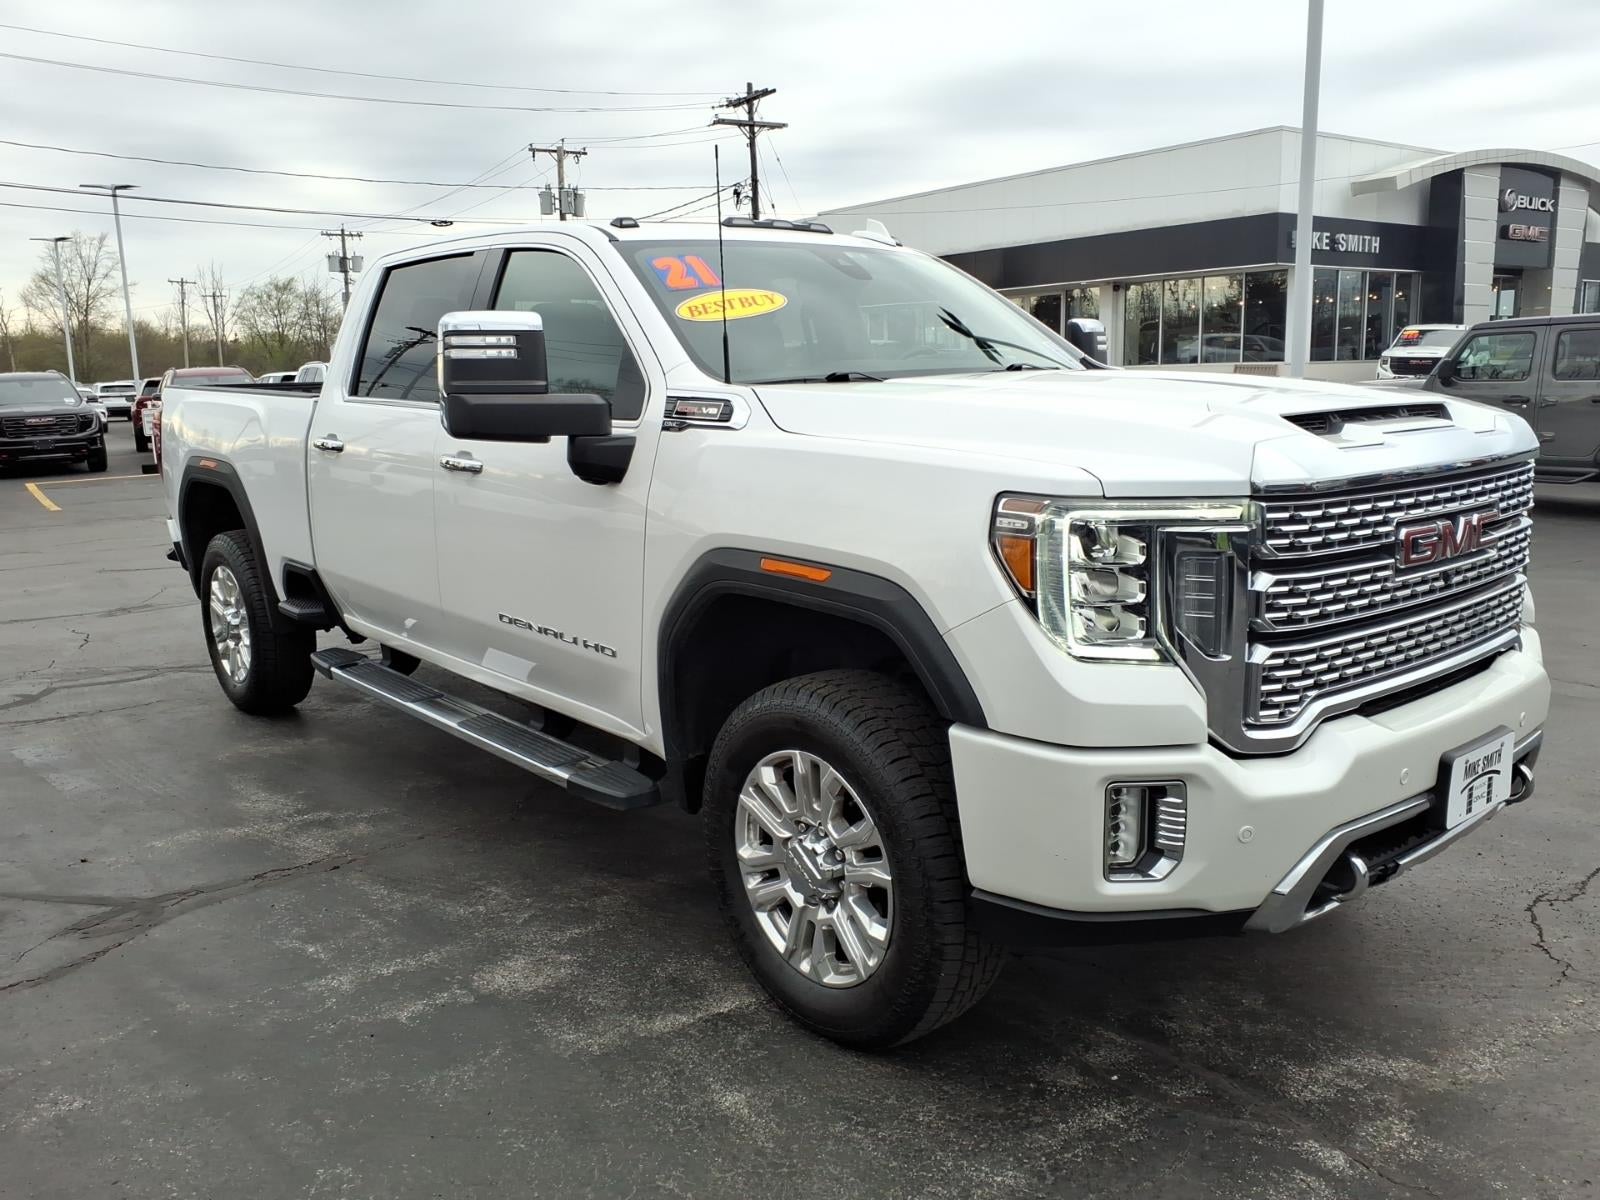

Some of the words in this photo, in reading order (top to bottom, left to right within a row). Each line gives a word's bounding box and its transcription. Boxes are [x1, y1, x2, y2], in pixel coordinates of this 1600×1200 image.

[1517, 195, 1555, 212] BUICK
[1336, 233, 1380, 253] SMITH
[1509, 224, 1550, 241] GMC
[653, 256, 721, 290] 21
[687, 298, 734, 318] BEST
[738, 294, 776, 308] BUY
[1400, 511, 1498, 568] GMC
[498, 612, 578, 646] DENALI
[582, 639, 617, 658] HD
[1464, 760, 1481, 781] MIKE
[1482, 750, 1502, 771] SMITH
